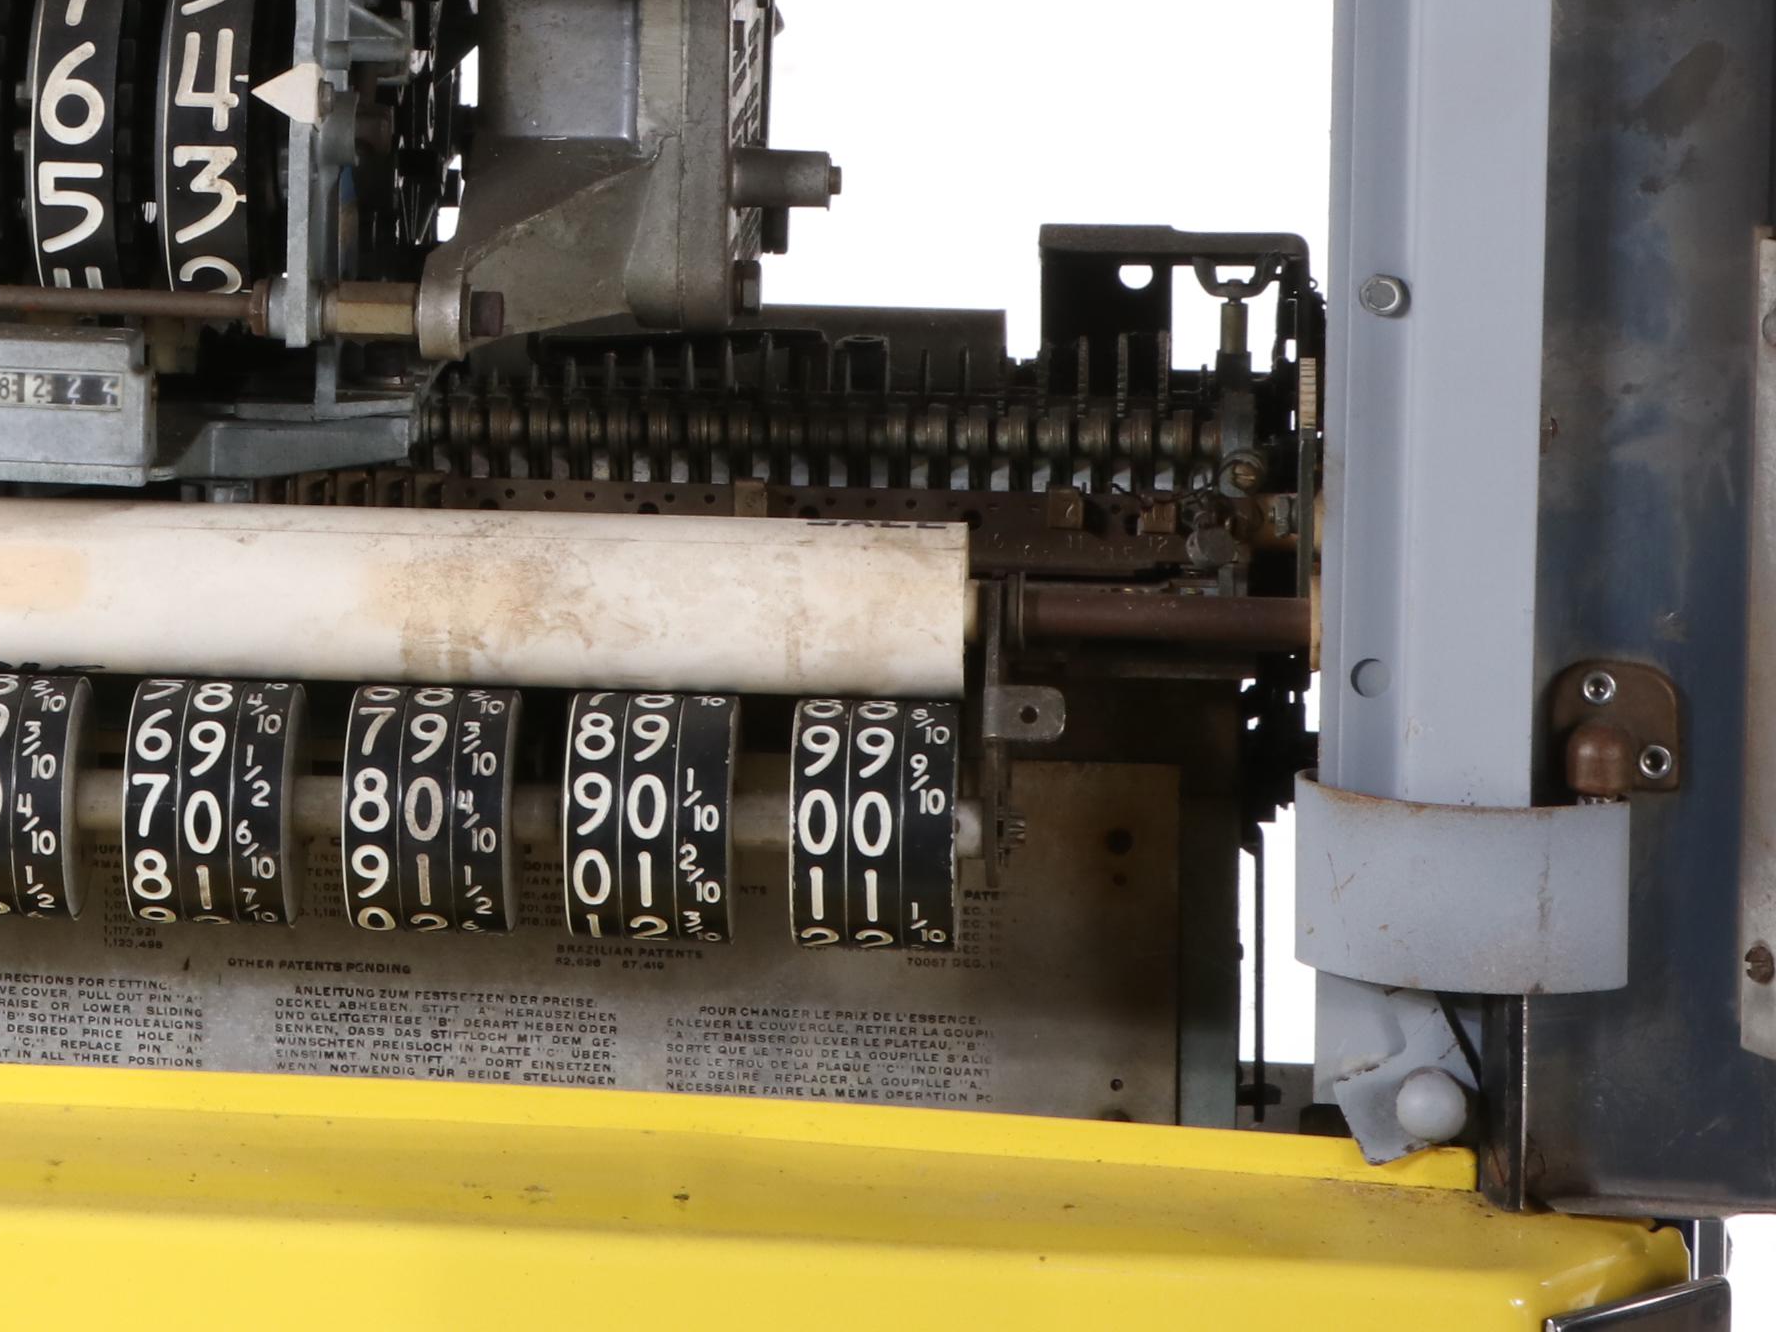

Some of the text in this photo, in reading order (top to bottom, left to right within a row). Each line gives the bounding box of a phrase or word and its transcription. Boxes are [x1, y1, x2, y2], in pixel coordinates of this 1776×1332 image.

[556, 944, 704, 959] BRAZILIAN PATENTS
[228, 958, 274, 968] OTHER
[279, 960, 342, 972] PATENTS
[78, 977, 104, 987] FOR
[79, 990, 111, 1000] PULL
[117, 993, 144, 1002] OUT
[149, 994, 171, 1003] PIN
[295, 986, 374, 998] ANLEITUNG
[380, 990, 408, 999] ZUM
[510, 995, 538, 1005] DER
[51, 1002, 70, 1011] OR
[83, 1003, 130, 1014] LOWER
[147, 1007, 203, 1017] SLIDING
[505, 1008, 616, 1021] HERAUSZIEHEN
[699, 1007, 891, 1021] POUR CHANGER LE PRIX DE
[29, 1013, 46, 1022] SO
[51, 1014, 84, 1024] THAT
[88, 1016, 109, 1025] PIN
[114, 1018, 149, 1027] HOLE
[153, 1019, 203, 1029] ALIGNS
[276, 1011, 304, 1020] UND
[311, 1013, 422, 1025] GLEITGETRIEBE
[464, 1019, 518, 1029] DERART
[525, 1021, 573, 1032] HEBEN
[579, 1025, 617, 1034] ODER
[7, 1024, 68, 1035] DESIRED
[82, 1029, 122, 1039] PRICE
[138, 1031, 174, 1041] HOLE
[189, 1034, 203, 1042] IN
[275, 1024, 339, 1036] SENKEN,
[348, 1027, 385, 1036] DASS
[395, 1029, 421, 1037] DAS
[517, 1034, 542, 1043] MIT
[552, 1036, 582, 1045] DEM
[592, 1038, 616, 1047] GE-
[856, 1025, 916, 1035] RETIRER
[724, 1033, 786, 1044] BAISSER
[60, 1040, 121, 1051] REPLACE
[138, 1044, 161, 1053] PIN
[276, 1036, 616, 1060] WÜNSCHTEN PREISLOCH PLATTE ÜBER-
[17, 1050, 31, 1058] IN
[41, 1051, 65, 1061] ALL
[74, 1053, 119, 1063] THREE
[128, 1056, 203, 1067] POSITIONS
[370, 1053, 399, 1062] NUN
[405, 1055, 442, 1064] STIFT
[485, 1058, 522, 1068] DORT
[869, 1051, 939, 1062] GOUPILLE
[330, 1064, 616, 1085] NOTWENDIG FÜR BEIDE STELLUNGEN
[881, 1078, 951, 1088] GOUPILLE
[763, 1086, 803, 1095] FAIRE
